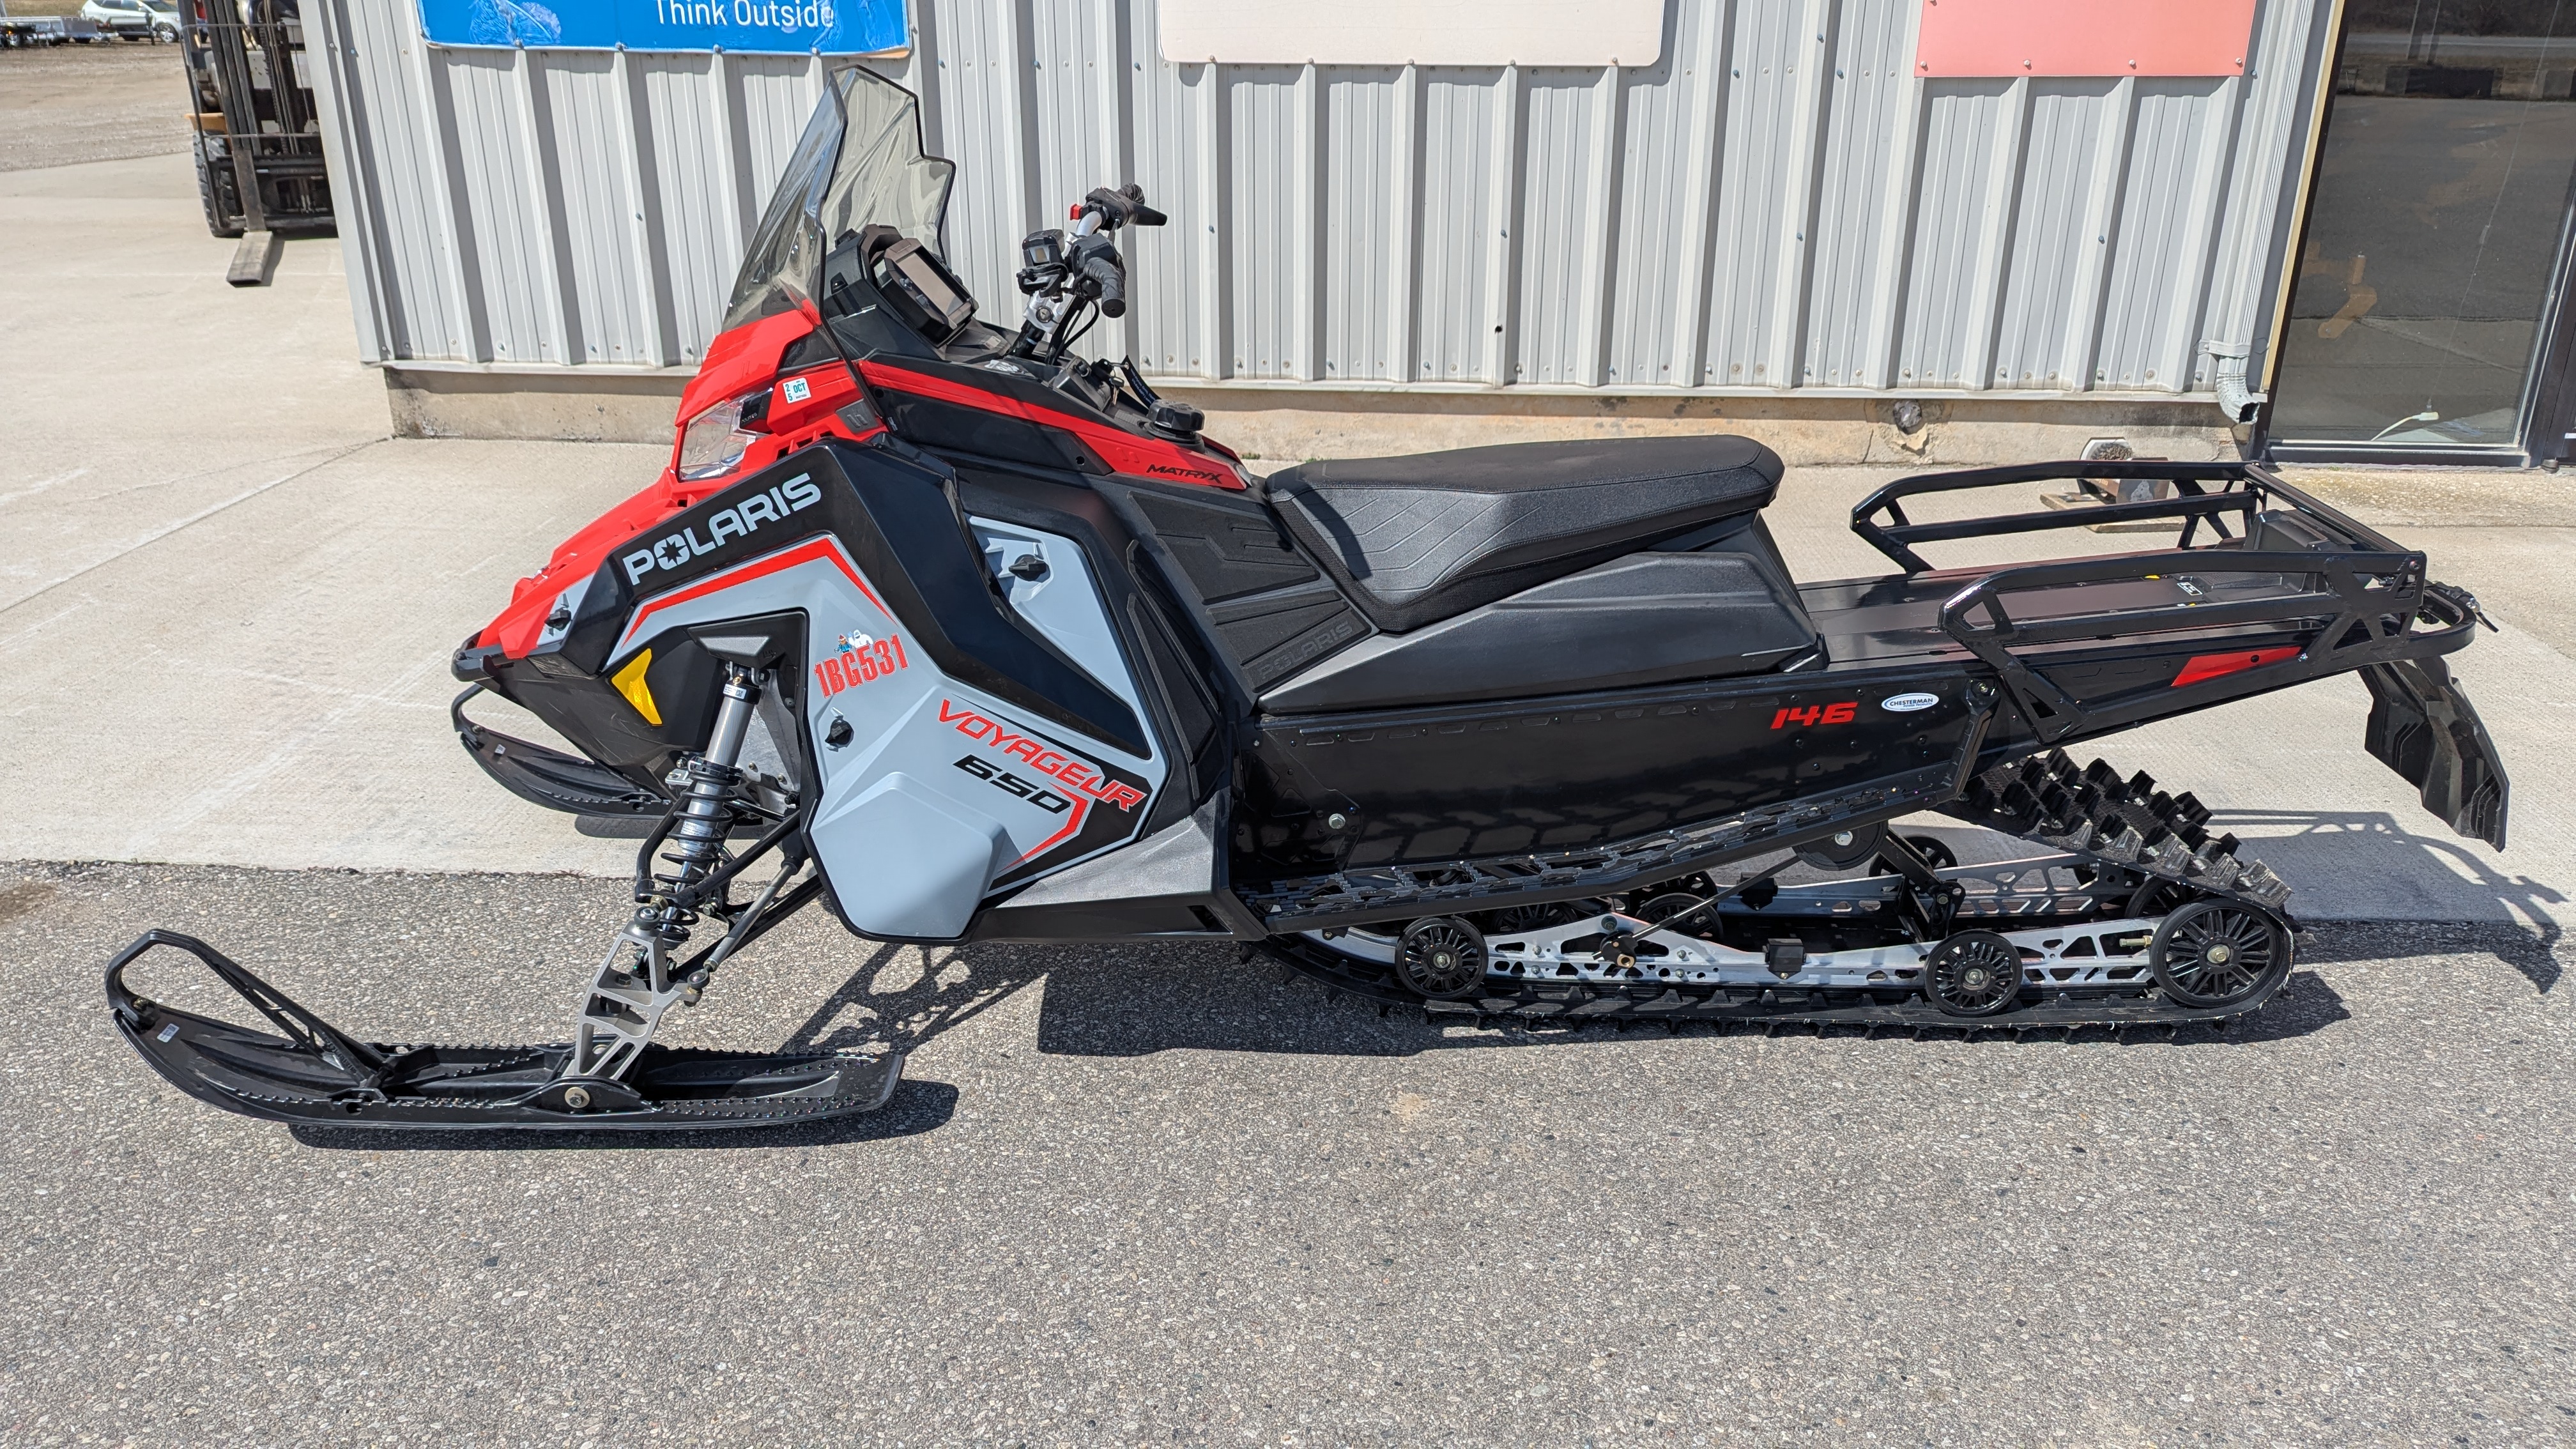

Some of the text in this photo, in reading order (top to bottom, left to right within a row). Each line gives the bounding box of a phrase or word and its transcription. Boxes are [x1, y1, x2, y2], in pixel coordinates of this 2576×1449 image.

[652, 0, 834, 27] Think Outside
[793, 382, 806, 394] OCT
[1146, 464, 1223, 484] MATRYX
[622, 472, 822, 586] POLARIS
[814, 632, 910, 699] 1BG531
[1257, 620, 1353, 680] POLARIS
[1770, 701, 1859, 730] 146
[1889, 698, 1933, 707] CHESTERMAN
[938, 698, 1148, 813] VOYAGEUR
[952, 754, 1071, 815] 650
